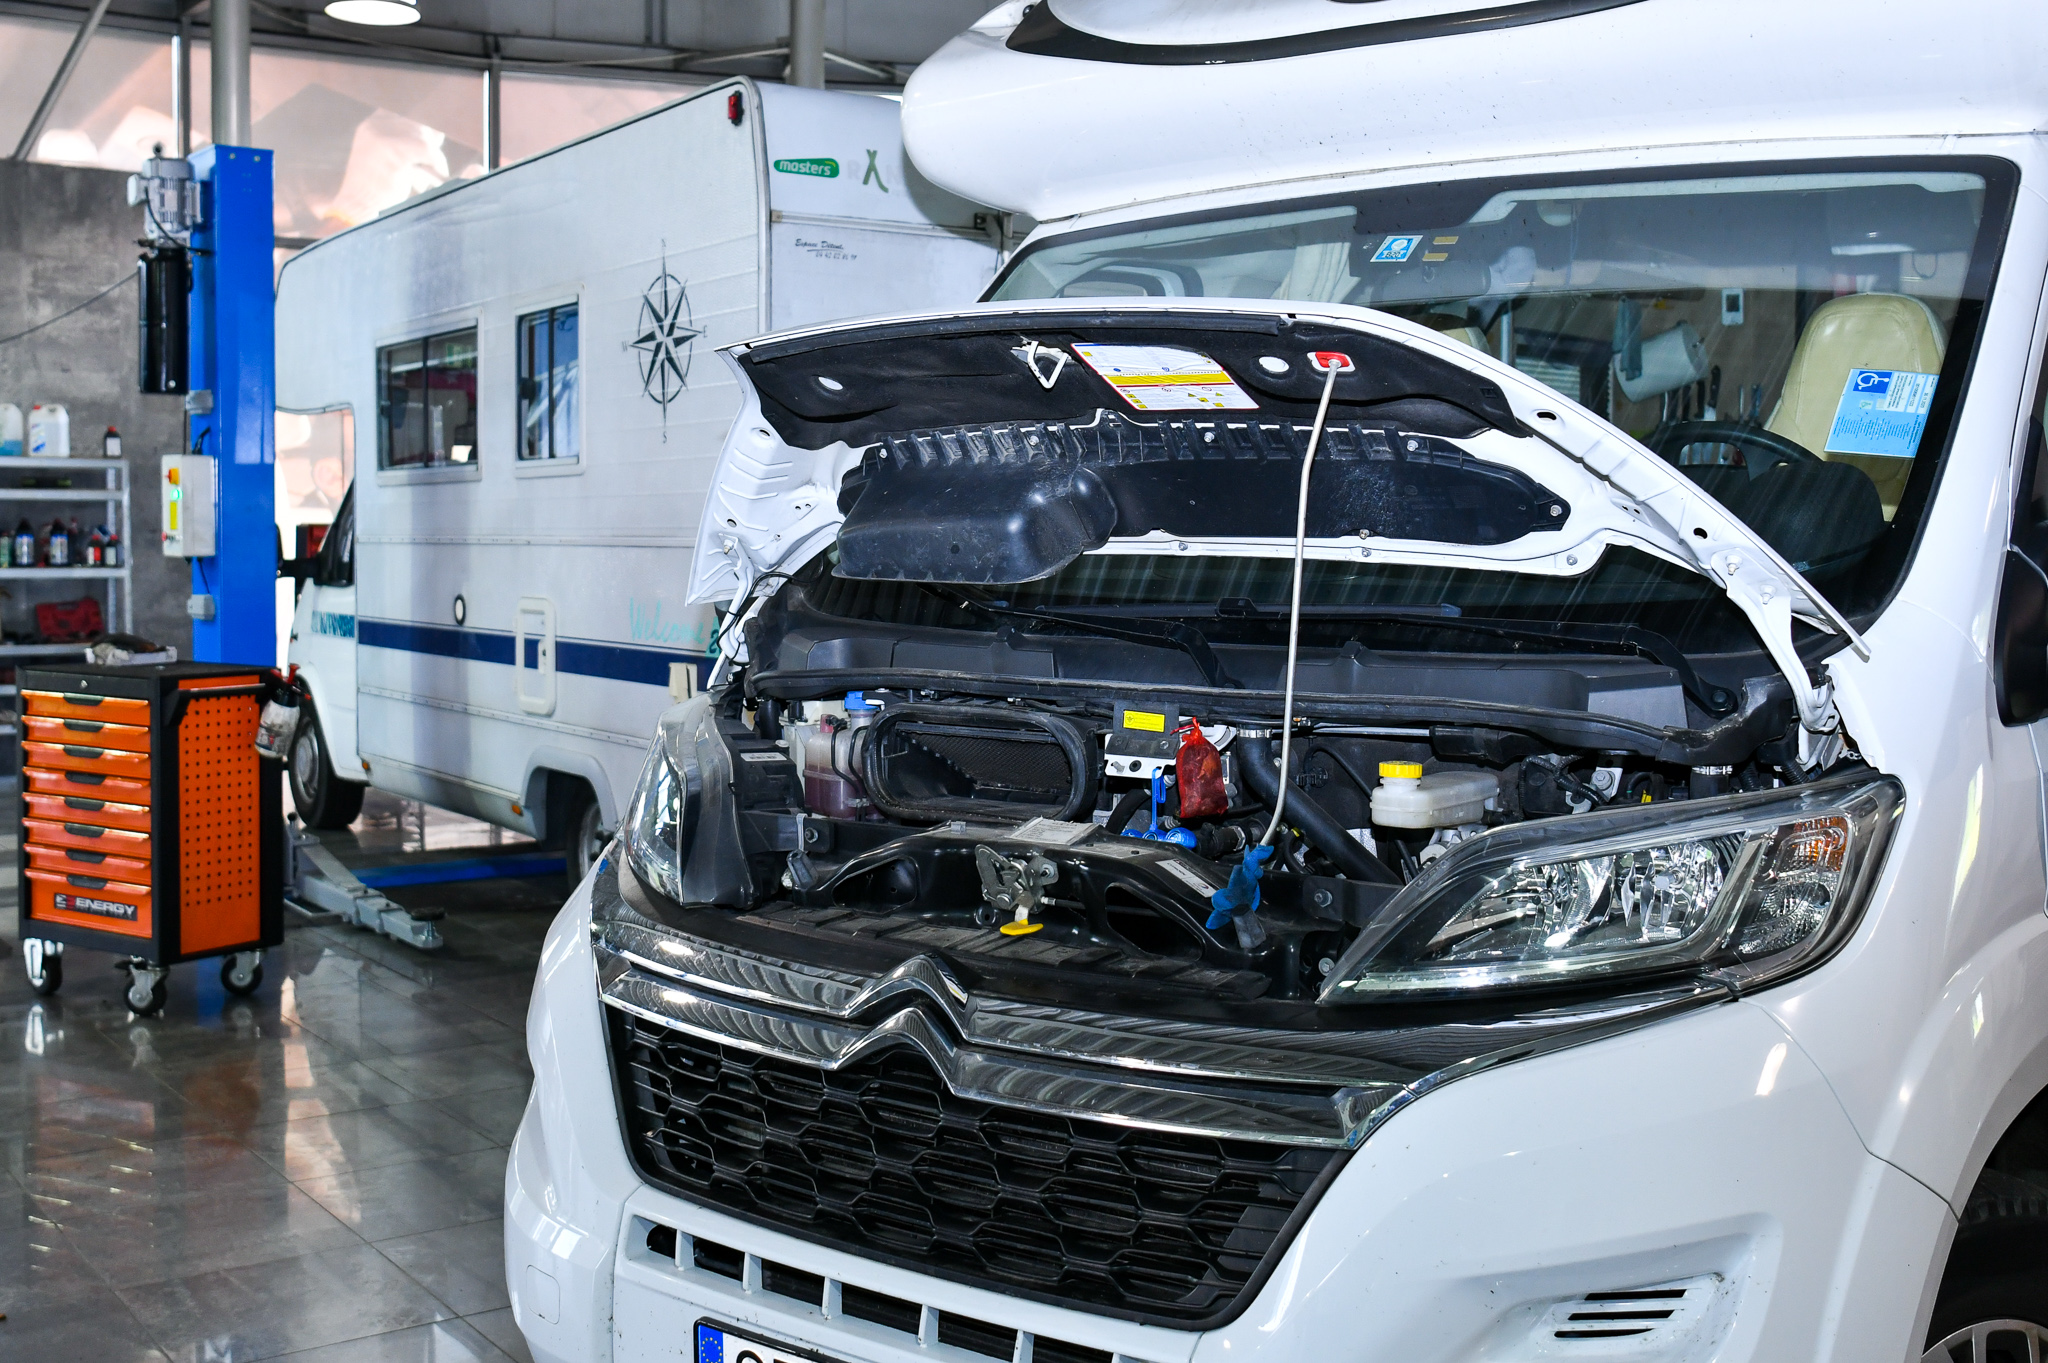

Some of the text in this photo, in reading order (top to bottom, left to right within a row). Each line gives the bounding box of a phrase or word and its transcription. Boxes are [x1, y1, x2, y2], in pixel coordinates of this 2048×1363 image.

[780, 161, 831, 176] masters
[629, 597, 705, 644] Welcome
[75, 896, 136, 916] ENERGY
